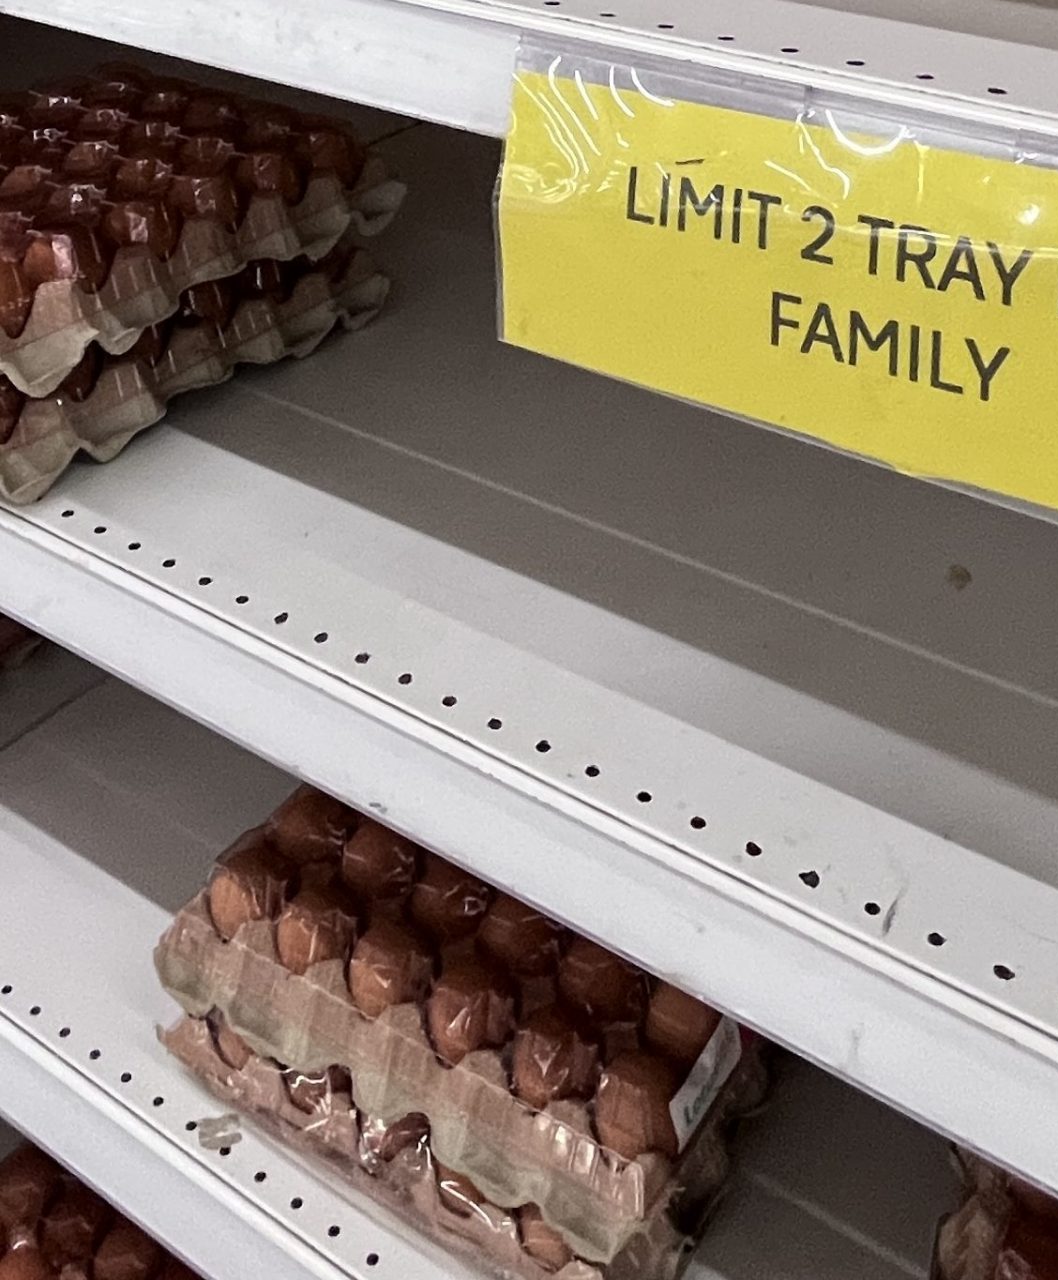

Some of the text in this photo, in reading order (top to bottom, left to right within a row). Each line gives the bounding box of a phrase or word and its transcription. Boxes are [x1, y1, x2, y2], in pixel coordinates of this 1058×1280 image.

[626, 166, 782, 250] LIMIT
[800, 205, 836, 265] 2
[857, 214, 1034, 306] TRAY
[770, 291, 1010, 402] FAMILY
